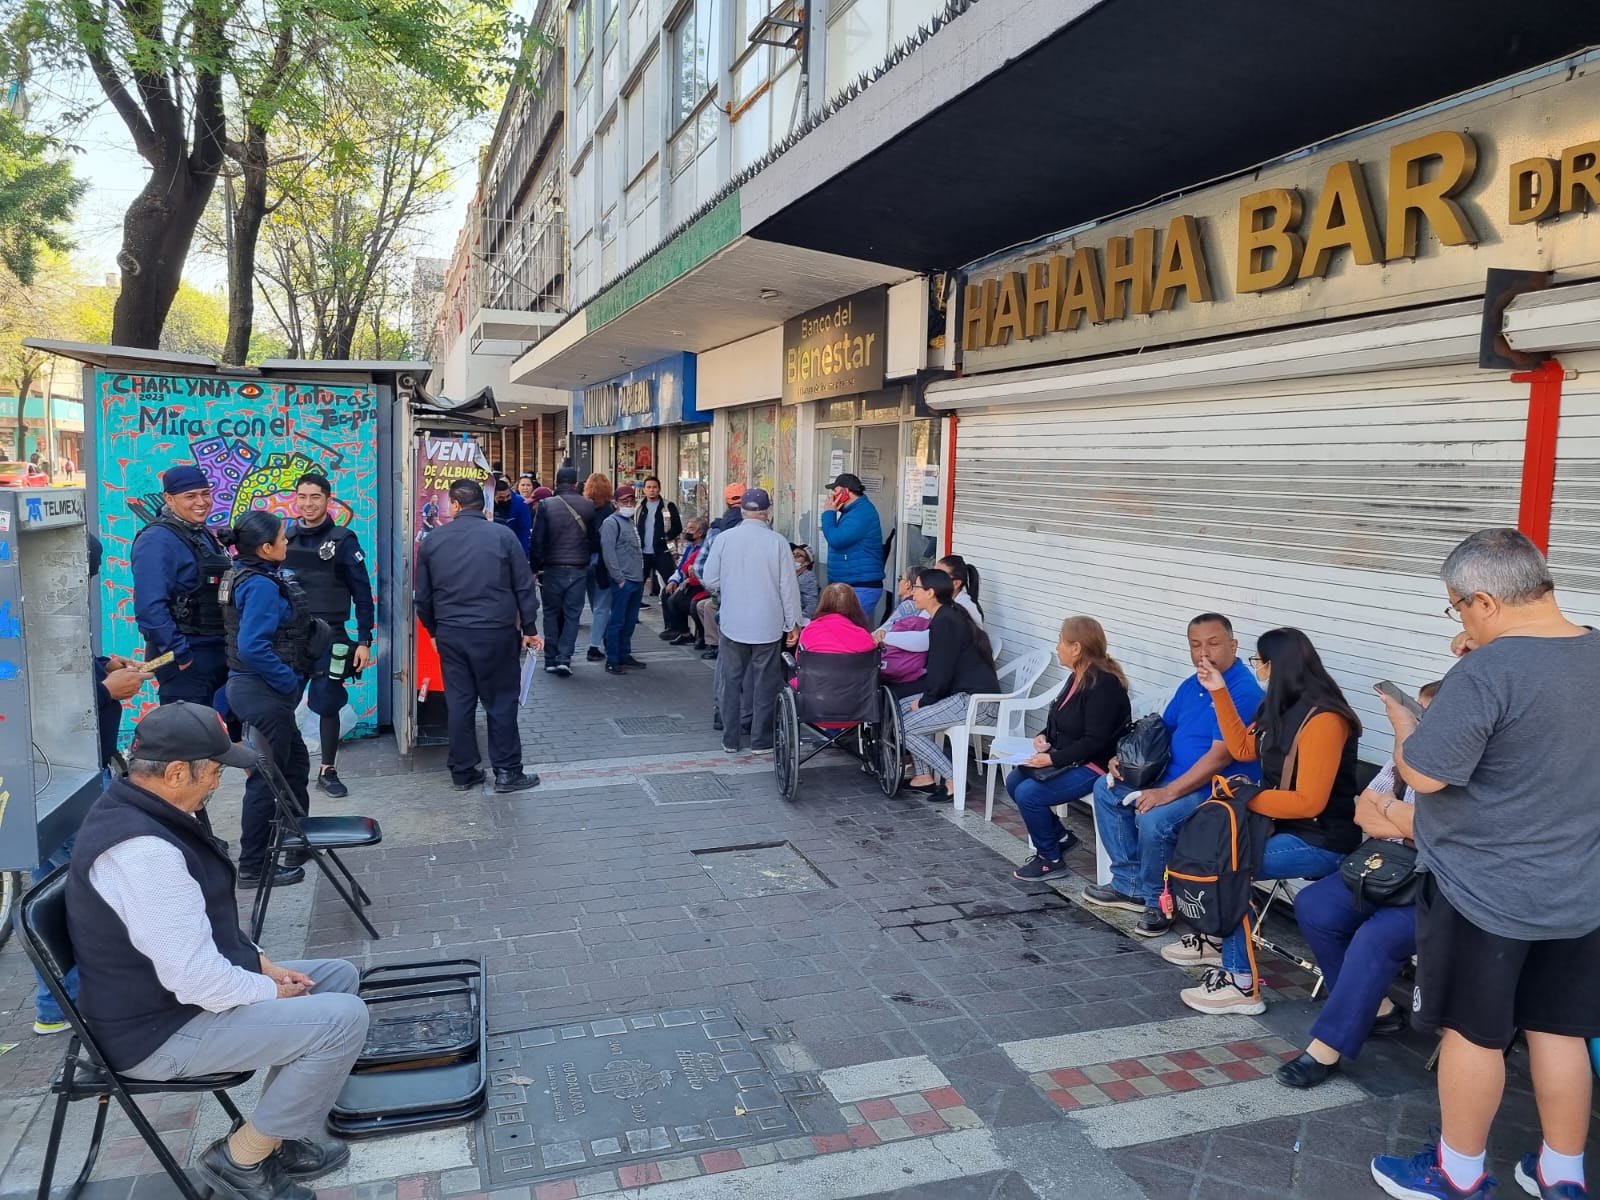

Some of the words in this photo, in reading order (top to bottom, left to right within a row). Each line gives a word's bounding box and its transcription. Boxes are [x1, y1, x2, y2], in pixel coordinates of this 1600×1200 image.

[963, 214, 1212, 352] HAHAHA
[1236, 130, 1478, 294] BAR
[801, 314, 831, 339] Banco
[834, 300, 852, 328] del
[787, 331, 875, 385] Bienestar
[112, 375, 231, 398] CHARLYNA
[139, 393, 164, 402] 2023
[139, 405, 206, 436] Mira
[425, 441, 476, 462] VENT
[424, 464, 438, 477] DE
[439, 463, 489, 480] ÁLBUMES
[424, 477, 432, 489] Y
[43, 499, 76, 517] TELMEX
